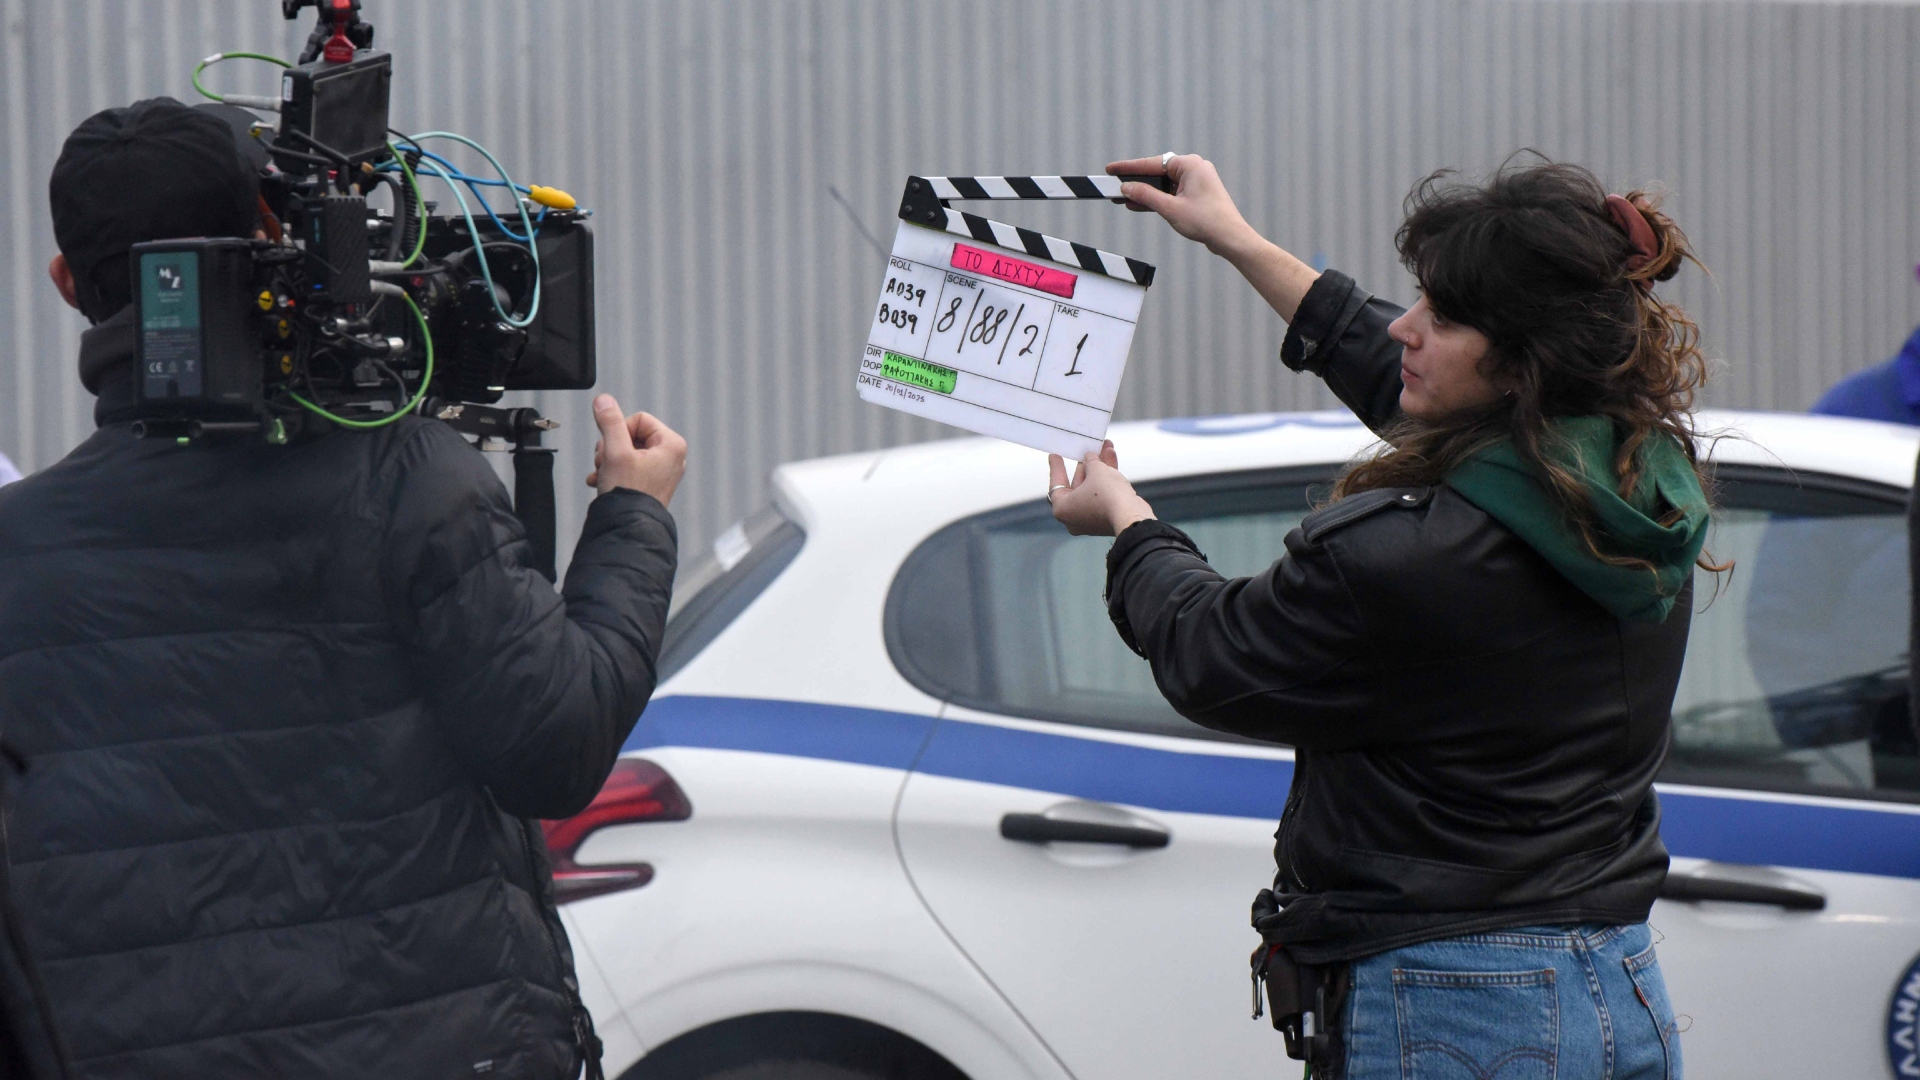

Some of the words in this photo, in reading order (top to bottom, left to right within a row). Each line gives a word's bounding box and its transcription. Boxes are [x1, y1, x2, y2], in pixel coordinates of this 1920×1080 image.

[890, 258, 912, 272] ROLL
[946, 274, 977, 290] SCENE
[886, 277, 926, 308] A039
[1056, 304, 1080, 318] TAKE
[866, 346, 882, 358] DIR
[863, 359, 883, 371] DOP
[858, 374, 882, 389] DATE
